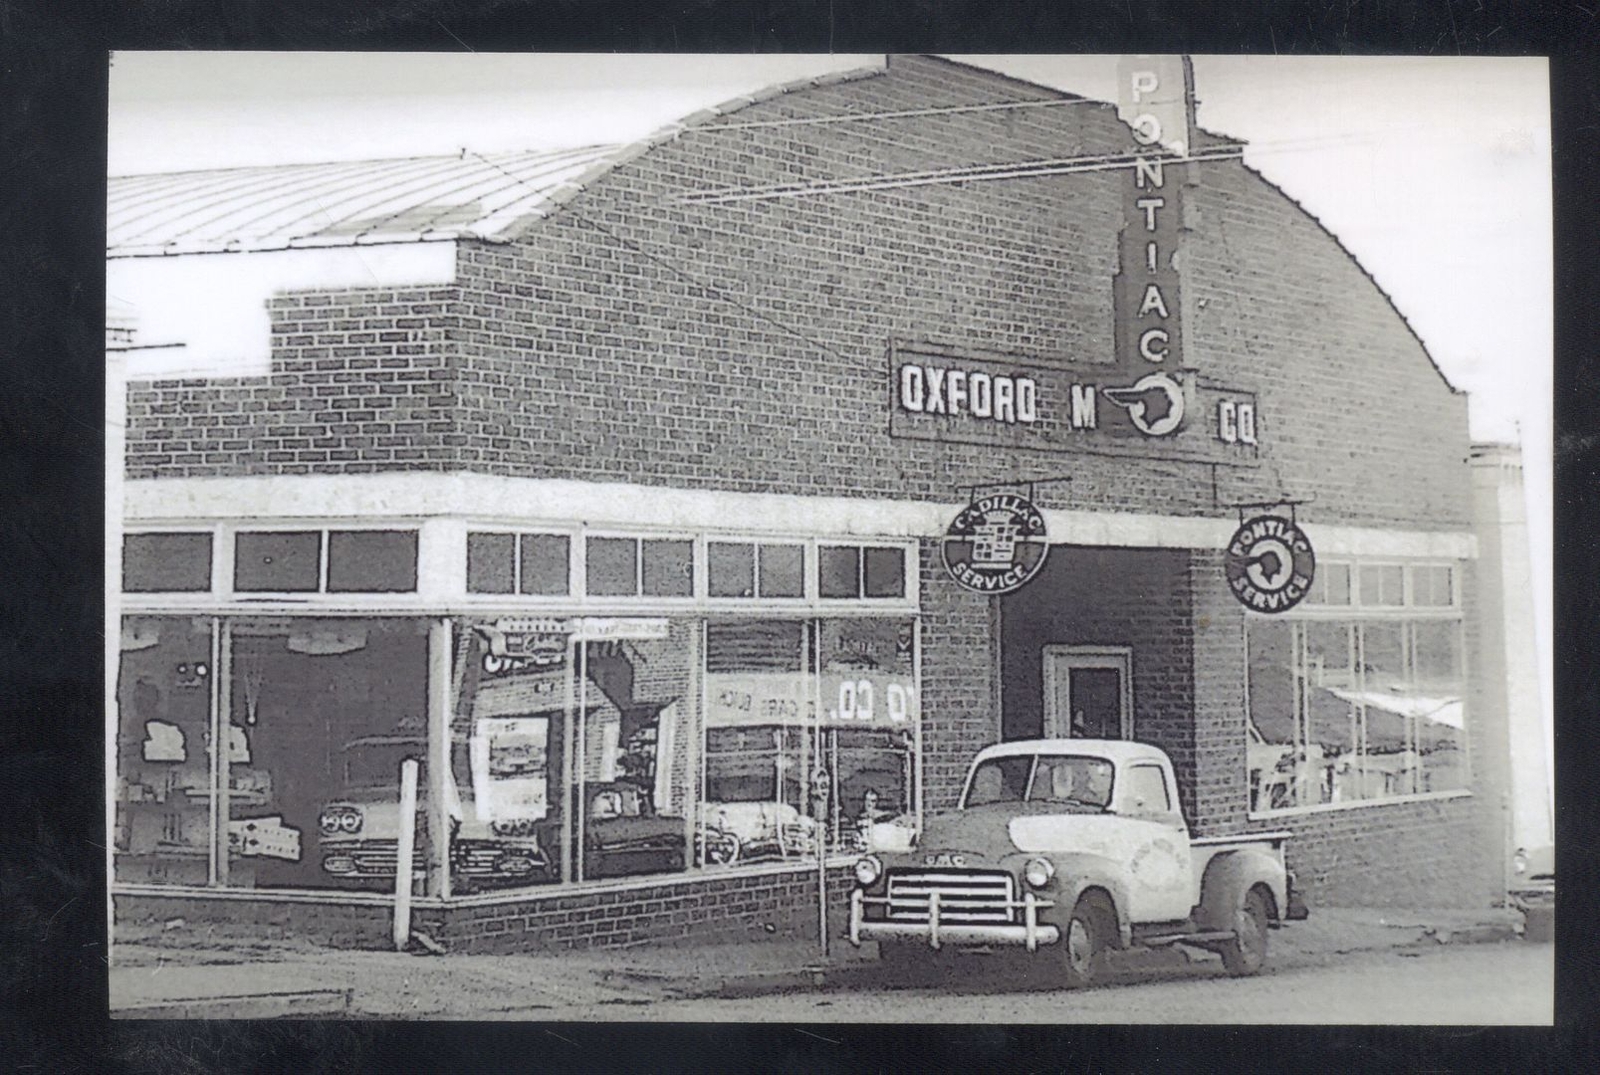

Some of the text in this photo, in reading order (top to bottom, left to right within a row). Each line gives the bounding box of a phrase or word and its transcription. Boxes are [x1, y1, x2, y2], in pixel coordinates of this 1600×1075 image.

[1131, 71, 1169, 362] PONTIAC
[901, 364, 1036, 423] OXFORD
[955, 496, 1042, 529] CADILLAC
[1231, 520, 1308, 556] PONTIAC
[952, 562, 1027, 589] SERVICE
[1232, 574, 1309, 609] SERVICE
